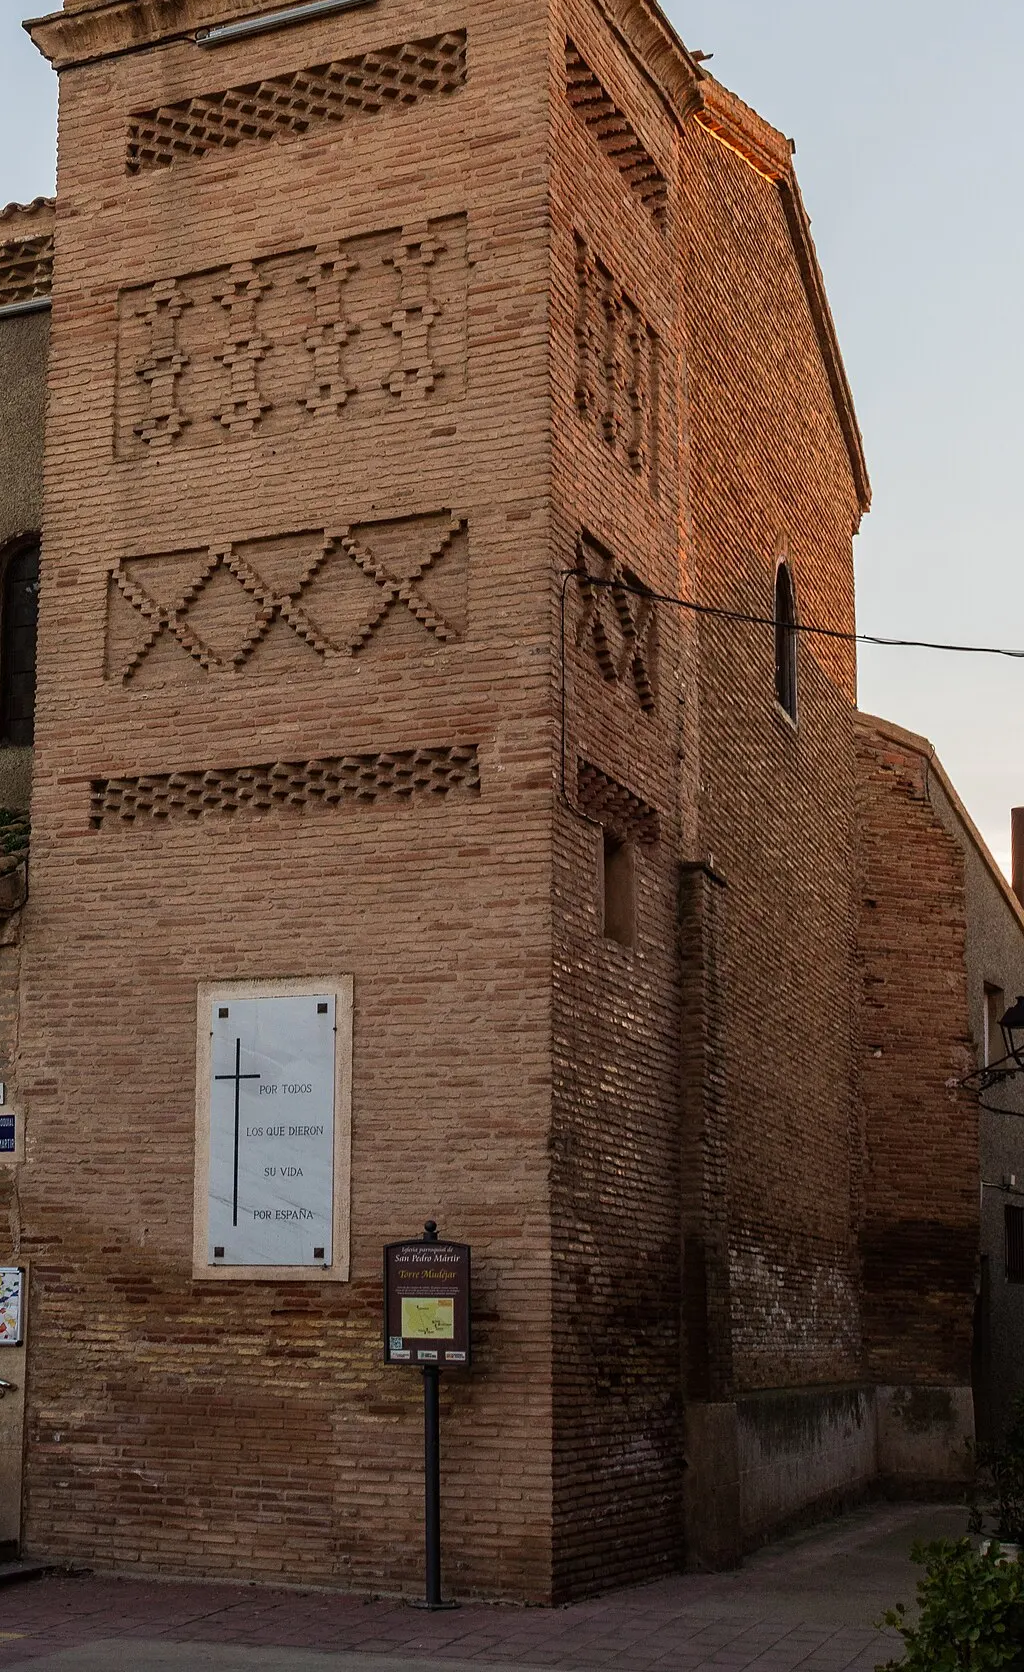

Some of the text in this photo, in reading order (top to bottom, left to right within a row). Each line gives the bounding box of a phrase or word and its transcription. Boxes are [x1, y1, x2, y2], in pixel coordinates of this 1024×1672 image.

[259, 1083, 312, 1095] POR TODOS
[246, 1125, 324, 1137] LOS QUE DIERON
[264, 1166, 304, 1177] SU VIDA
[253, 1208, 314, 1220] POR ESPAÑA
[395, 1254, 410, 1262] San
[411, 1253, 432, 1262] Pedro
[398, 1269, 421, 1279] Torre
